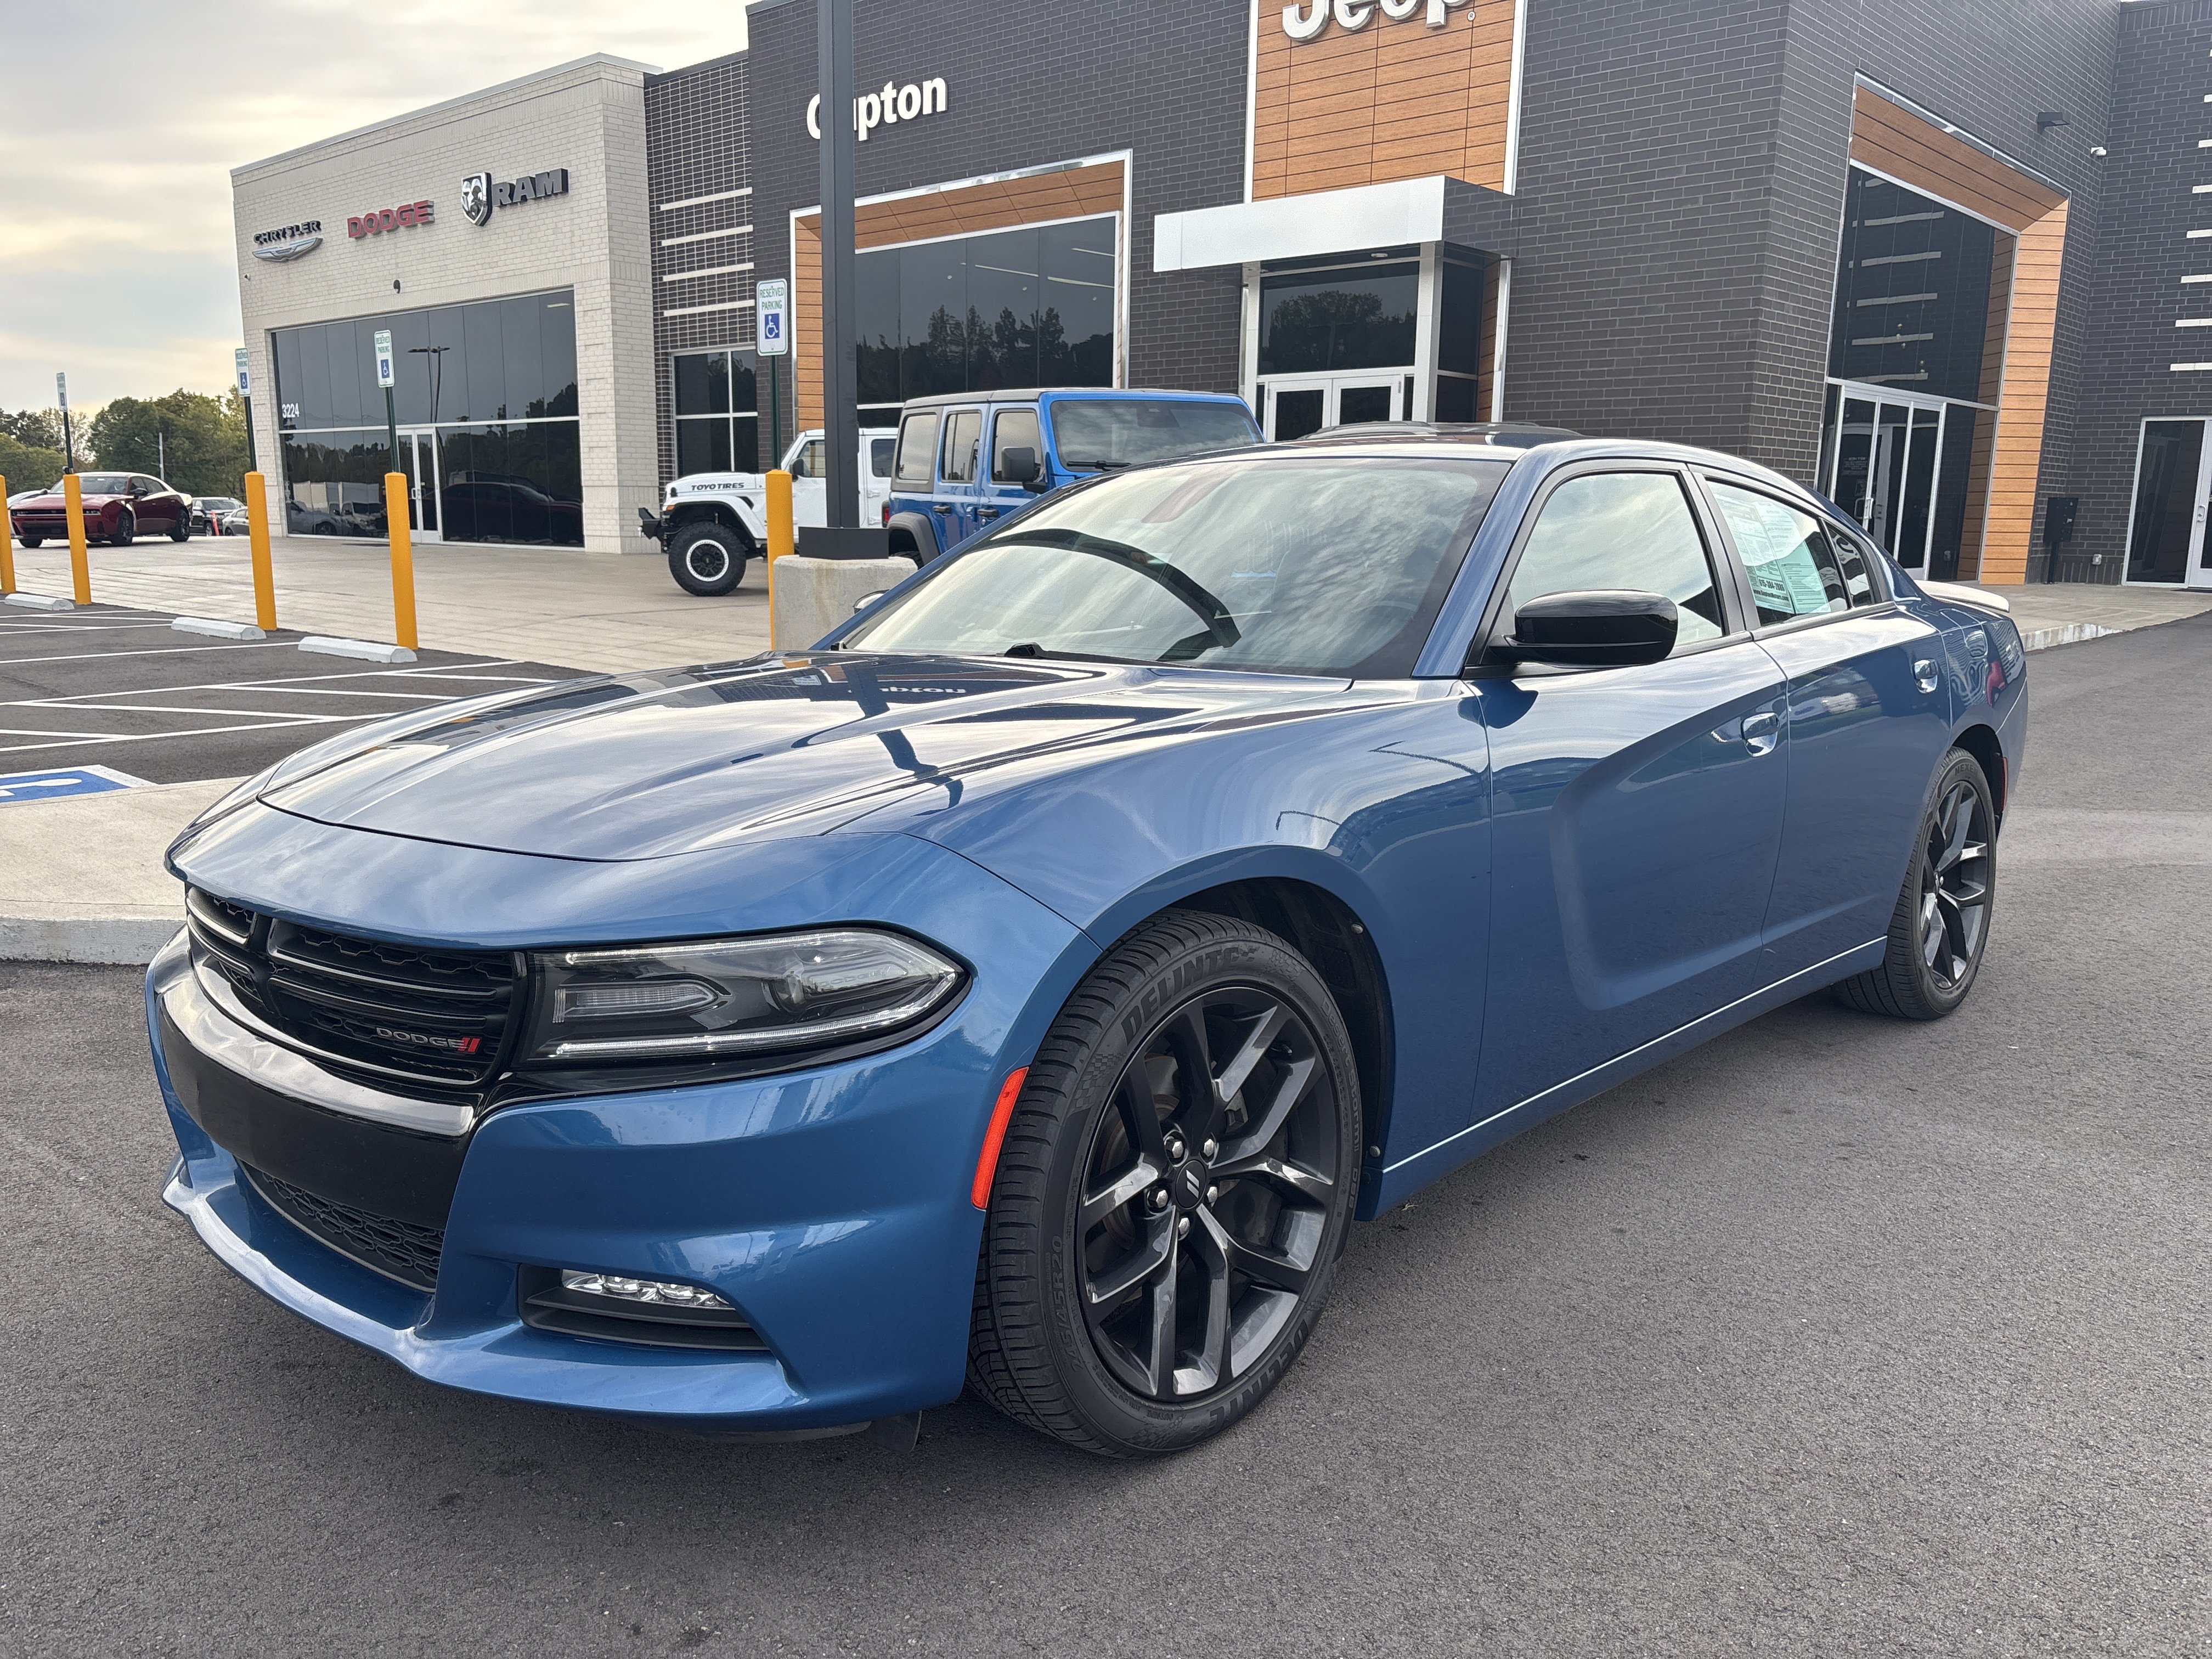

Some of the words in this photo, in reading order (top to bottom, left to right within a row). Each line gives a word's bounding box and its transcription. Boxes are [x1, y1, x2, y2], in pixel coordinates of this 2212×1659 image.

[492, 168, 568, 207] RAM
[347, 200, 435, 239] DODGE
[253, 220, 322, 244] CHRYSLER
[759, 287, 785, 298] RESERVED
[761, 300, 783, 311] PARKING
[282, 403, 300, 418] 3224
[376, 1027, 468, 1048] DODGE
[1321, 997, 1351, 1068] Desert
